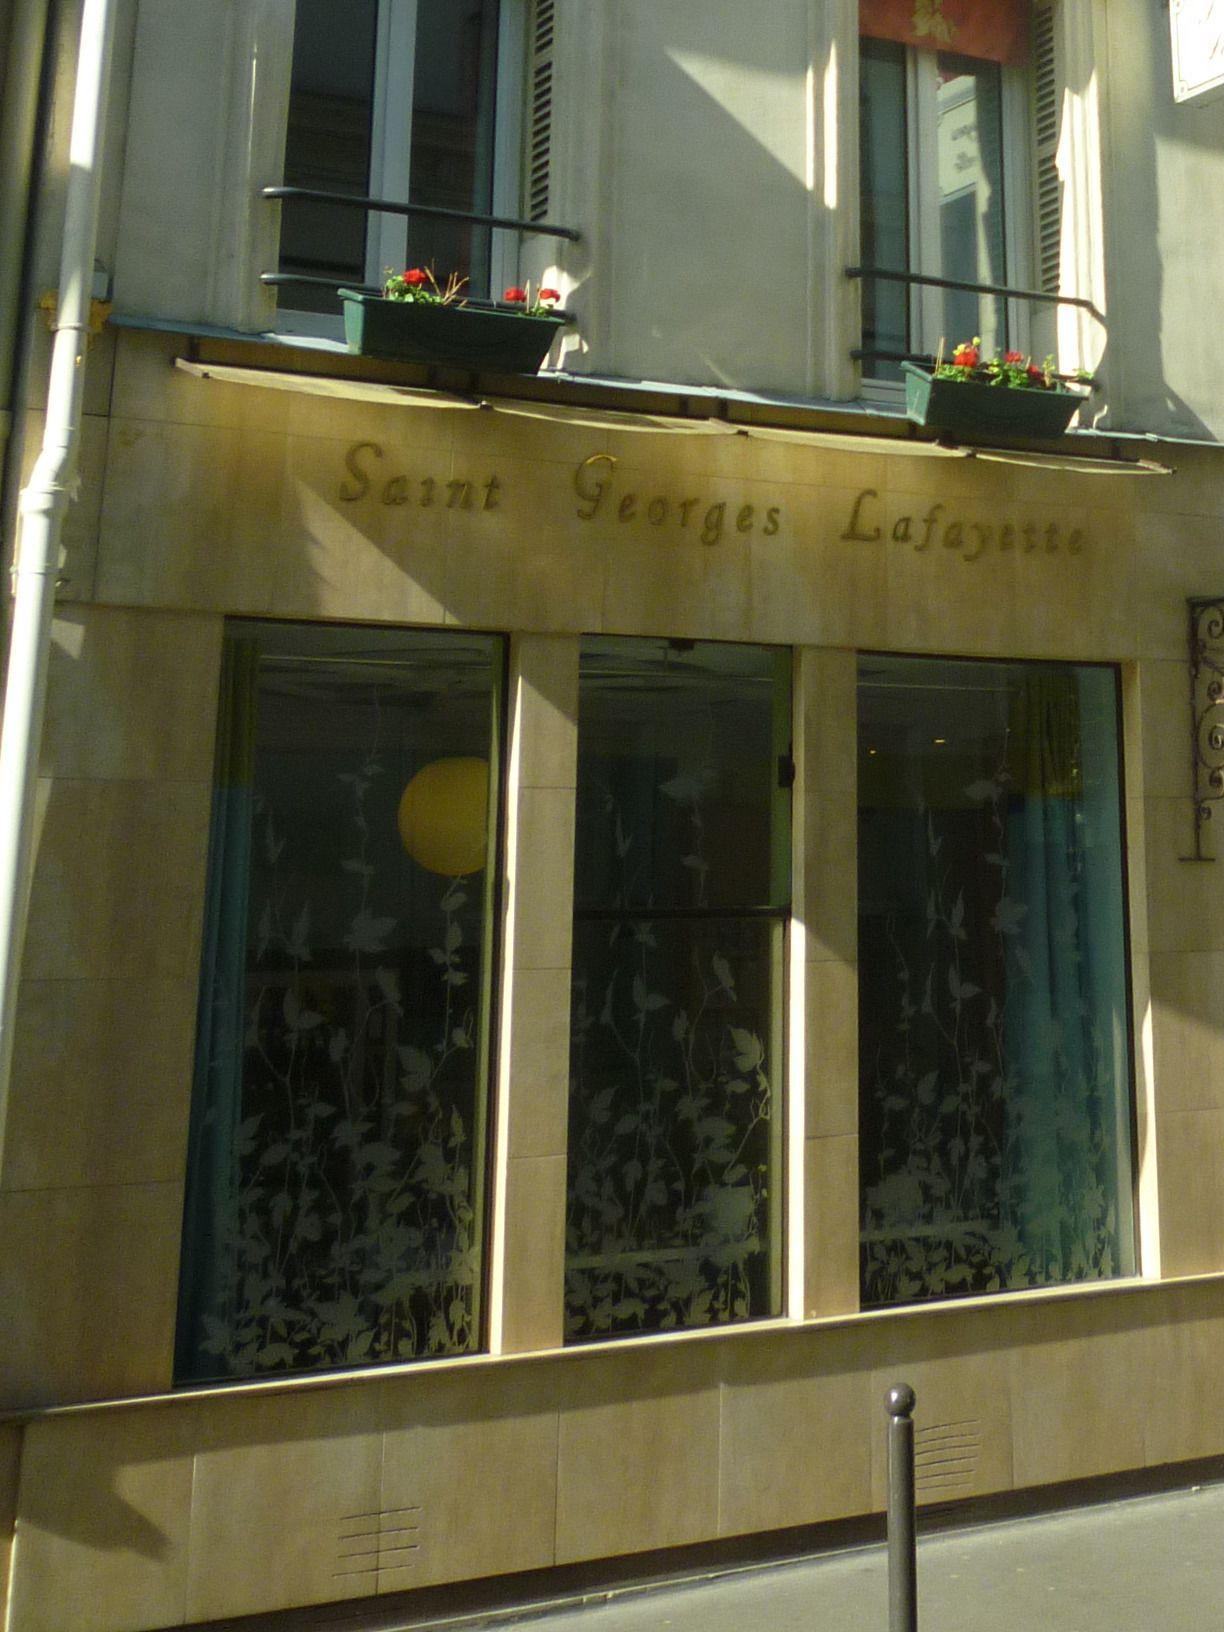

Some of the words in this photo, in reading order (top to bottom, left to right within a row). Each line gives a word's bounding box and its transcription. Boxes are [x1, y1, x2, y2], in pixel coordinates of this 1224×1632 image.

[339, 442, 500, 511] Saint
[574, 454, 780, 546] Georges
[841, 488, 1084, 563] Lafayette
